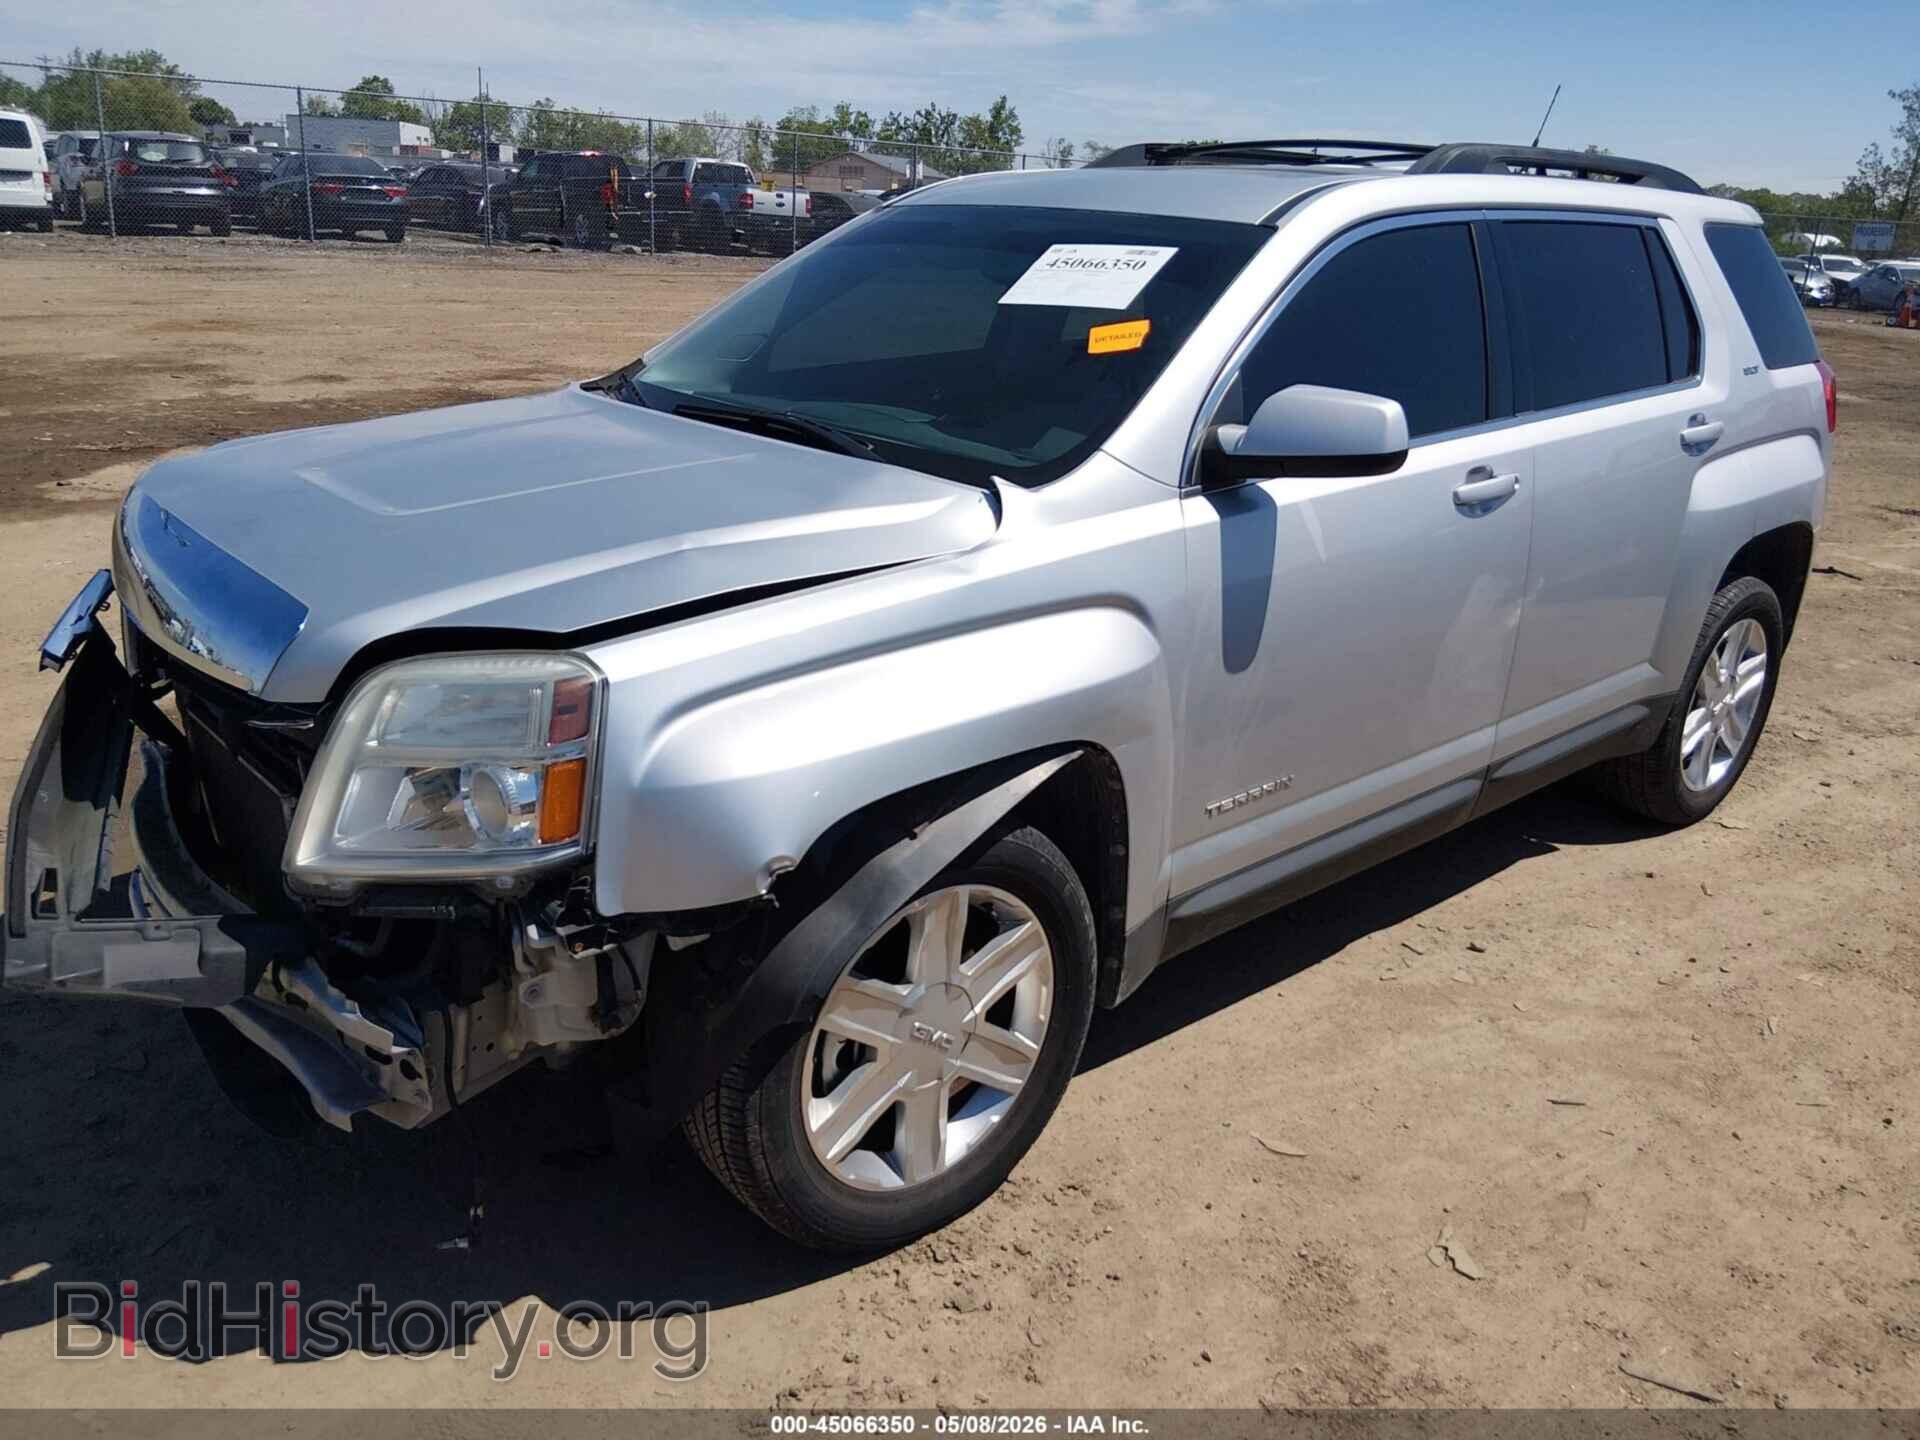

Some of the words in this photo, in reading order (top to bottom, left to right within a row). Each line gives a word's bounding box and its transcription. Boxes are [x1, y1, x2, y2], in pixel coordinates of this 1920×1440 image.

[1045, 257, 1147, 271] 45066350
[1205, 775, 1294, 818] TERRAIN
[912, 1021, 954, 1049] GMC
